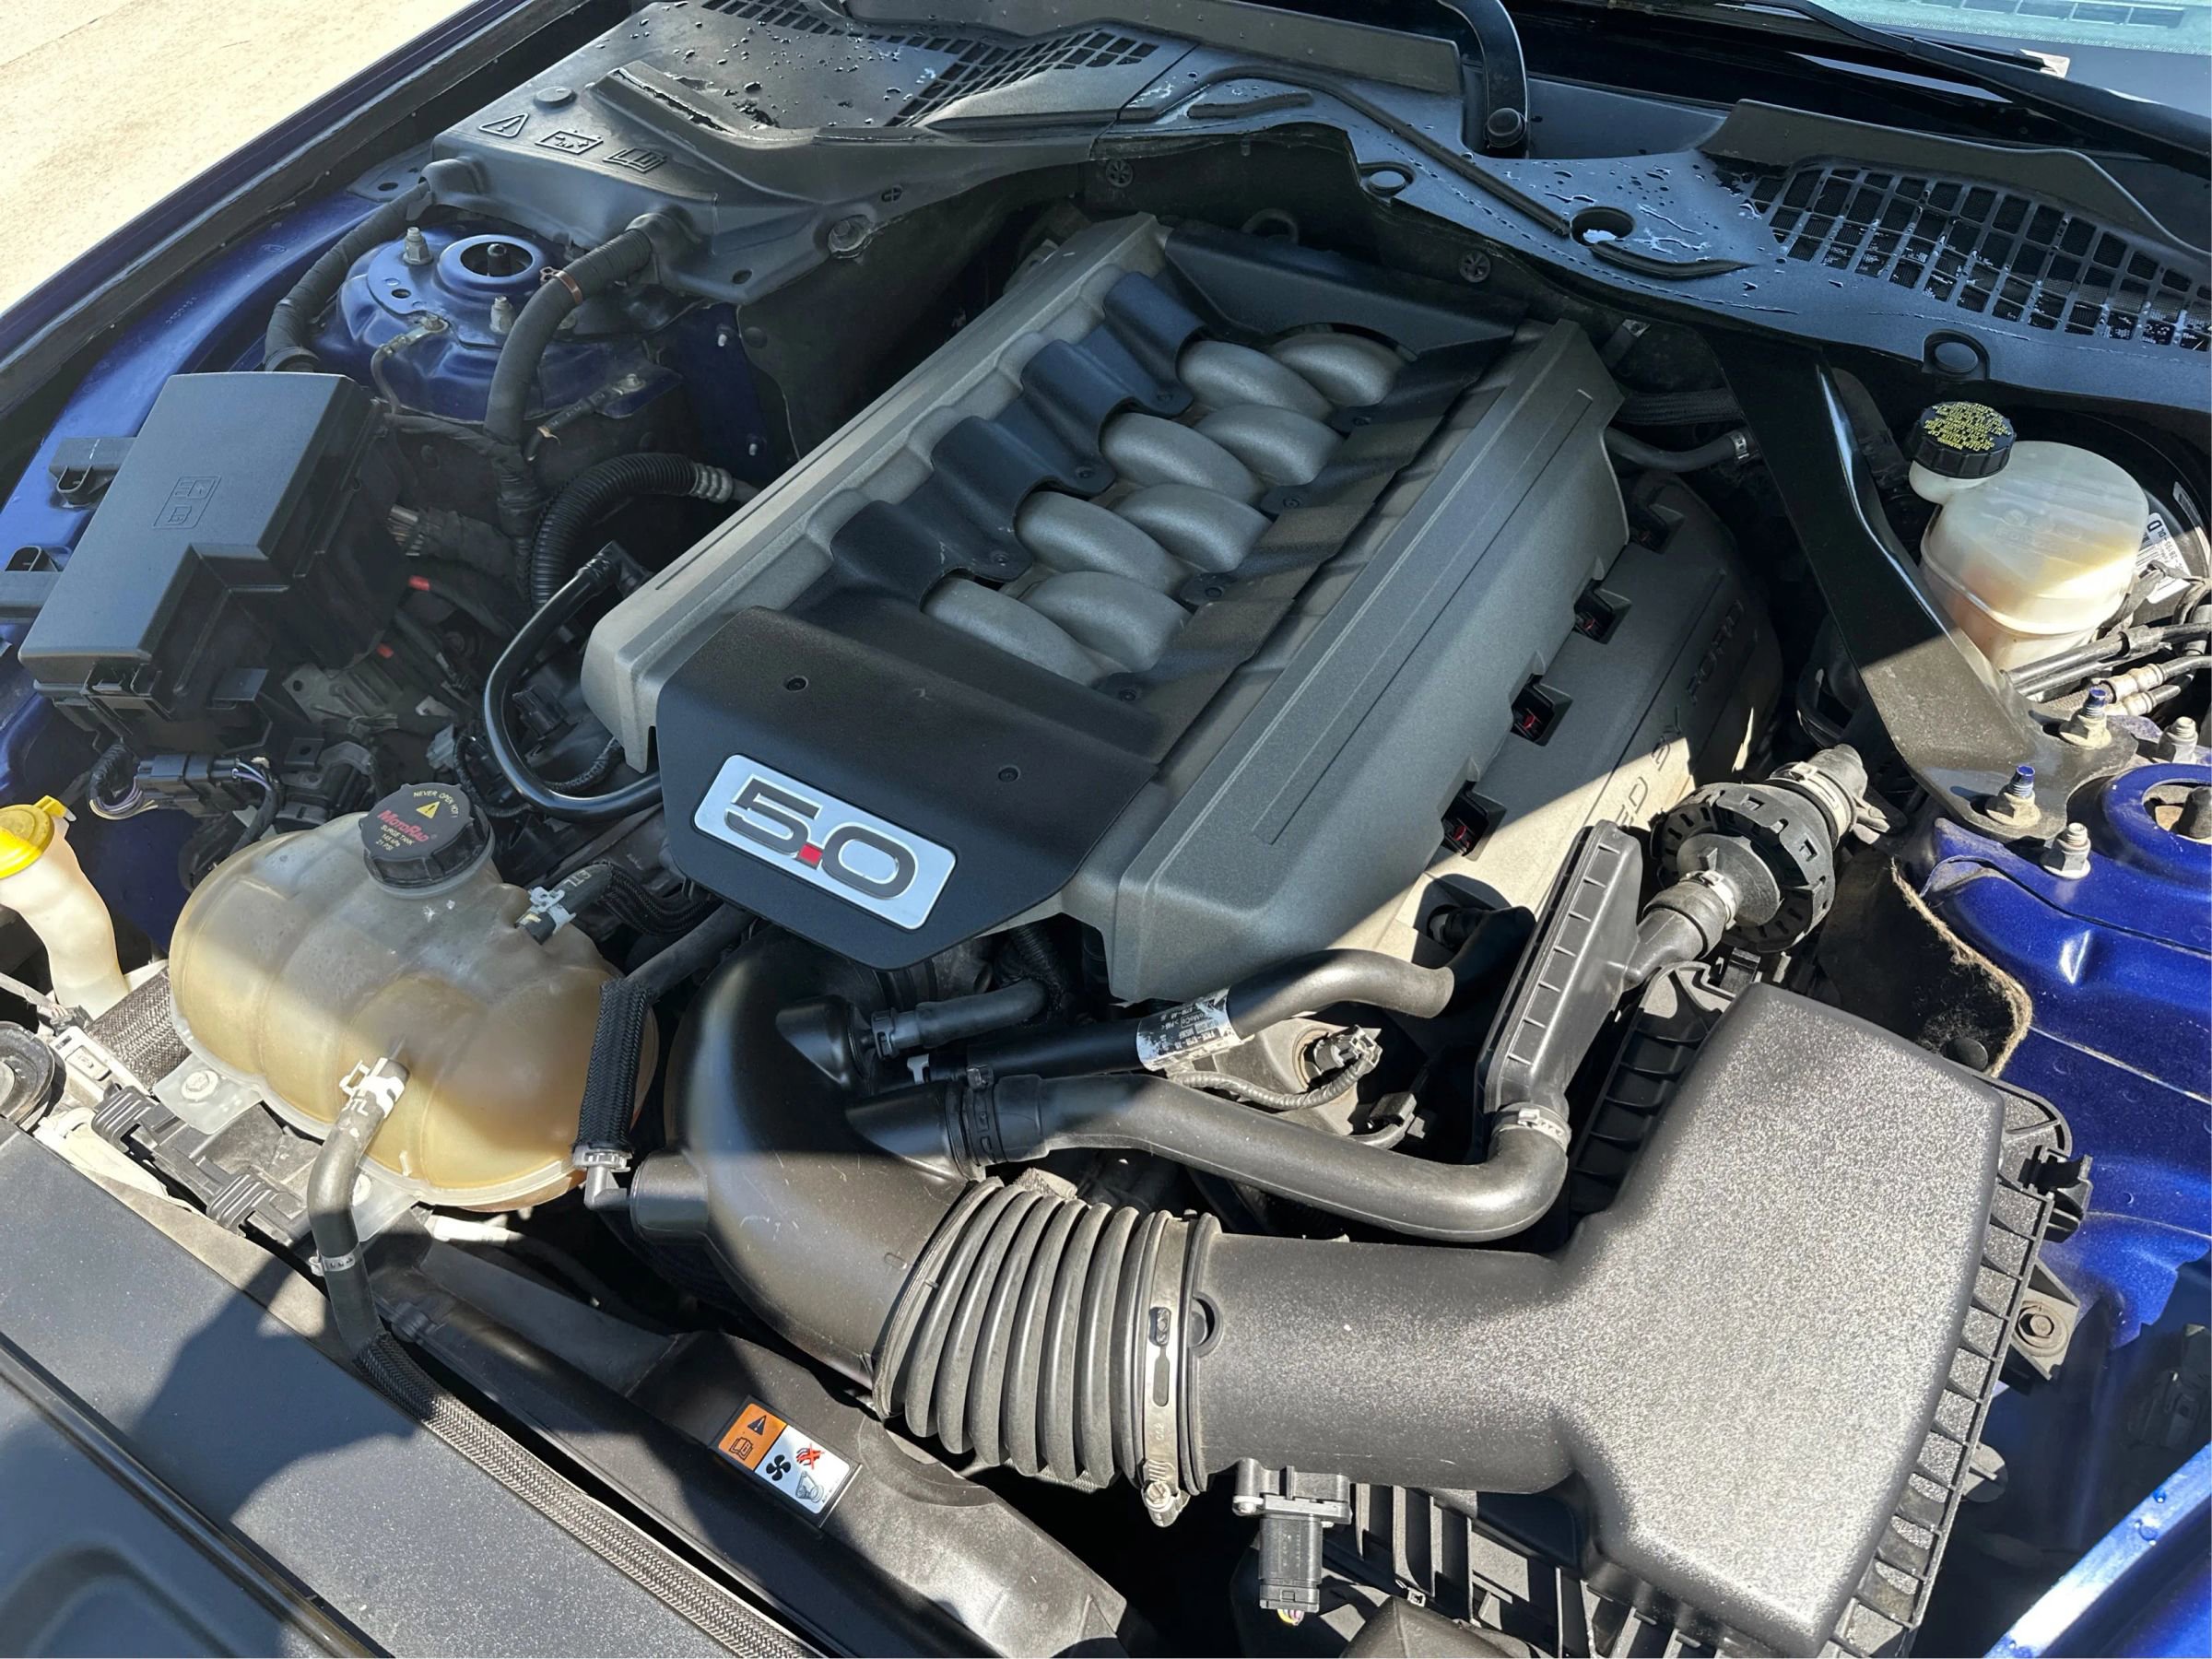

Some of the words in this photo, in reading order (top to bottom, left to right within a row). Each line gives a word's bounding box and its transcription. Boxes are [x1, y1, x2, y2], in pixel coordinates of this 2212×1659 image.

[2147, 519, 2162, 533] D
[1651, 705, 1681, 771] BY
[1688, 600, 1744, 705] FORD
[438, 793, 453, 804] OPEN
[380, 824, 401, 838] SURGE
[399, 834, 414, 845] TANK
[724, 773, 920, 901] 5.0
[382, 842, 394, 851] PSI
[1181, 1012, 1204, 1023] oMoCo
